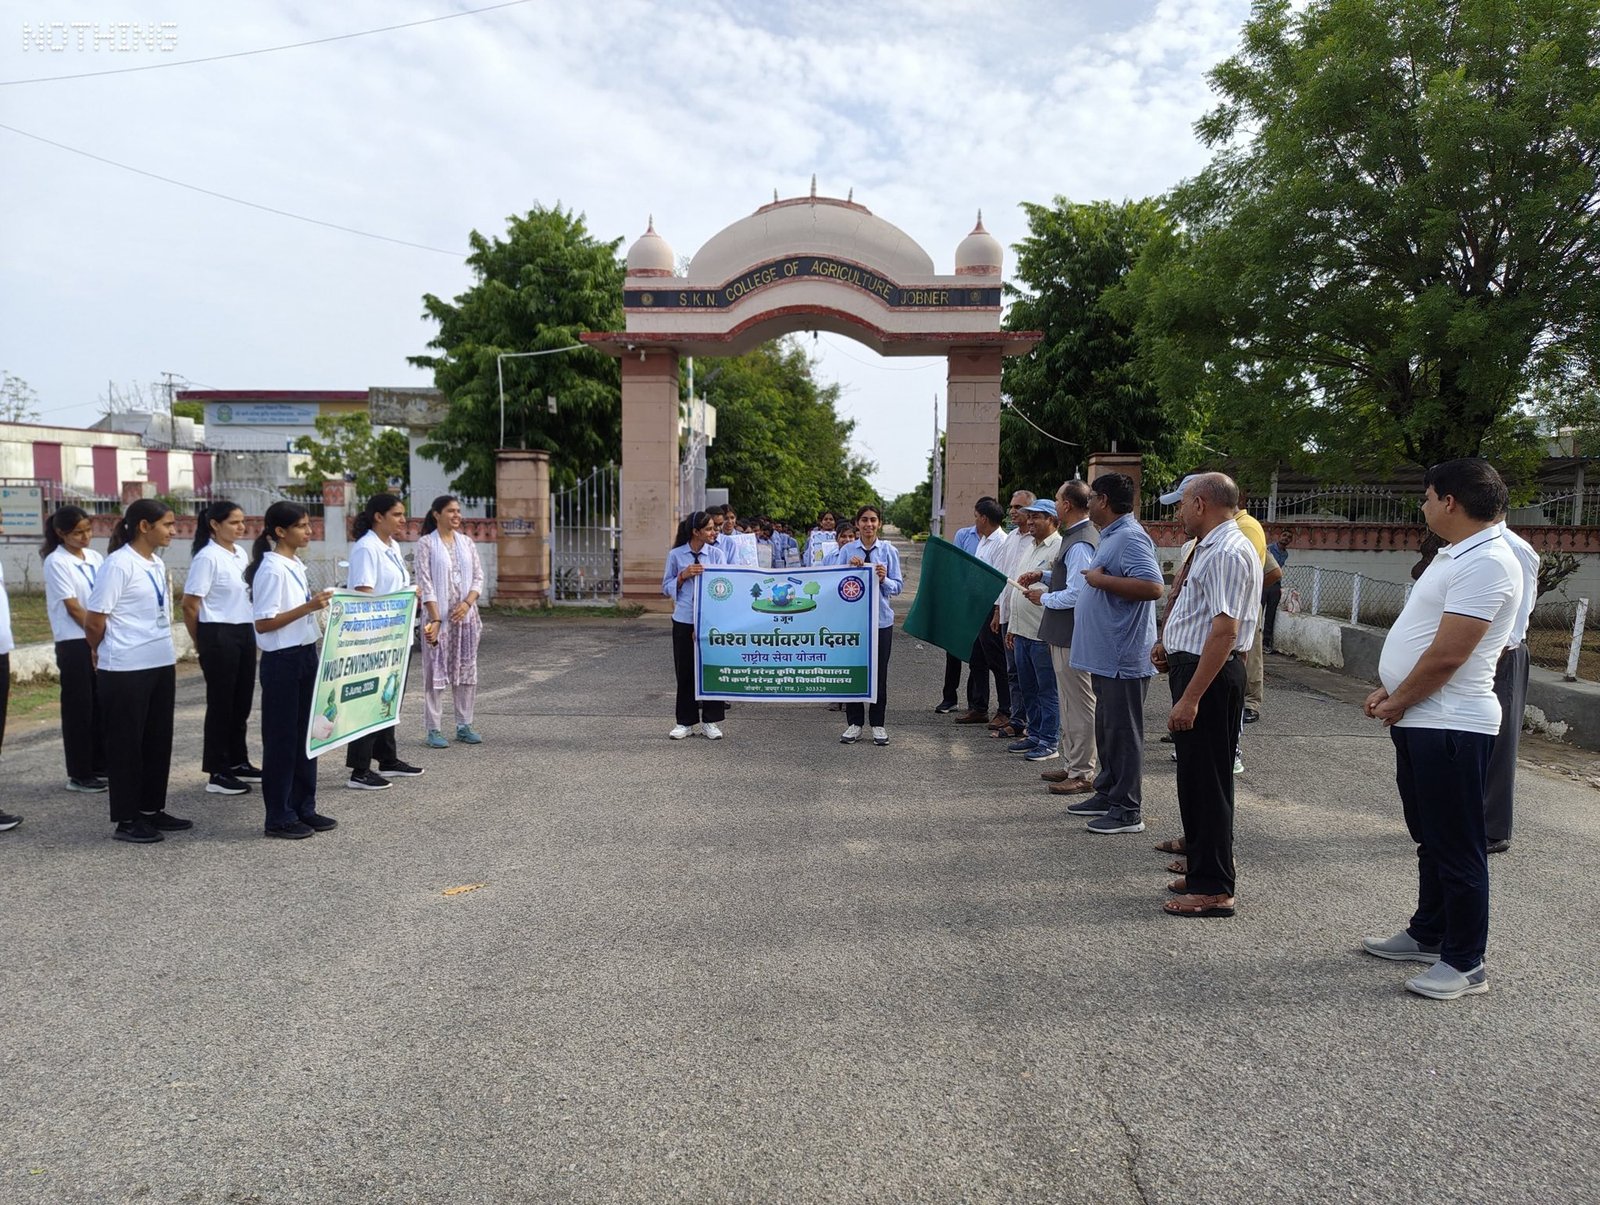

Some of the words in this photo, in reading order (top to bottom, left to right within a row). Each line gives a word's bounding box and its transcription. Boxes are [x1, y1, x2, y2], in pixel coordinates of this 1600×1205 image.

[725, 267, 779, 301] COLLEGE
[783, 261, 799, 277] OF
[811, 260, 893, 299] AGRICULTURE
[900, 290, 949, 305] JOBNER
[780, 615, 794, 624] जून
[709, 628, 747, 646] विश्व
[750, 628, 815, 646] पर्यावरण
[819, 627, 860, 648] दिवस
[343, 649, 392, 676] ENVIRONMENT
[392, 647, 405, 666] DAY
[741, 650, 769, 664] राष्ट्रीय
[772, 650, 793, 662] सेवा
[796, 650, 827, 662] योजना
[720, 667, 731, 675] श्री
[732, 667, 751, 675] कर्ण
[776, 667, 796, 676] कृषि
[797, 667, 850, 675] महाविद्यालय
[718, 675, 729, 683] श्री
[775, 676, 794, 685] कृषि
